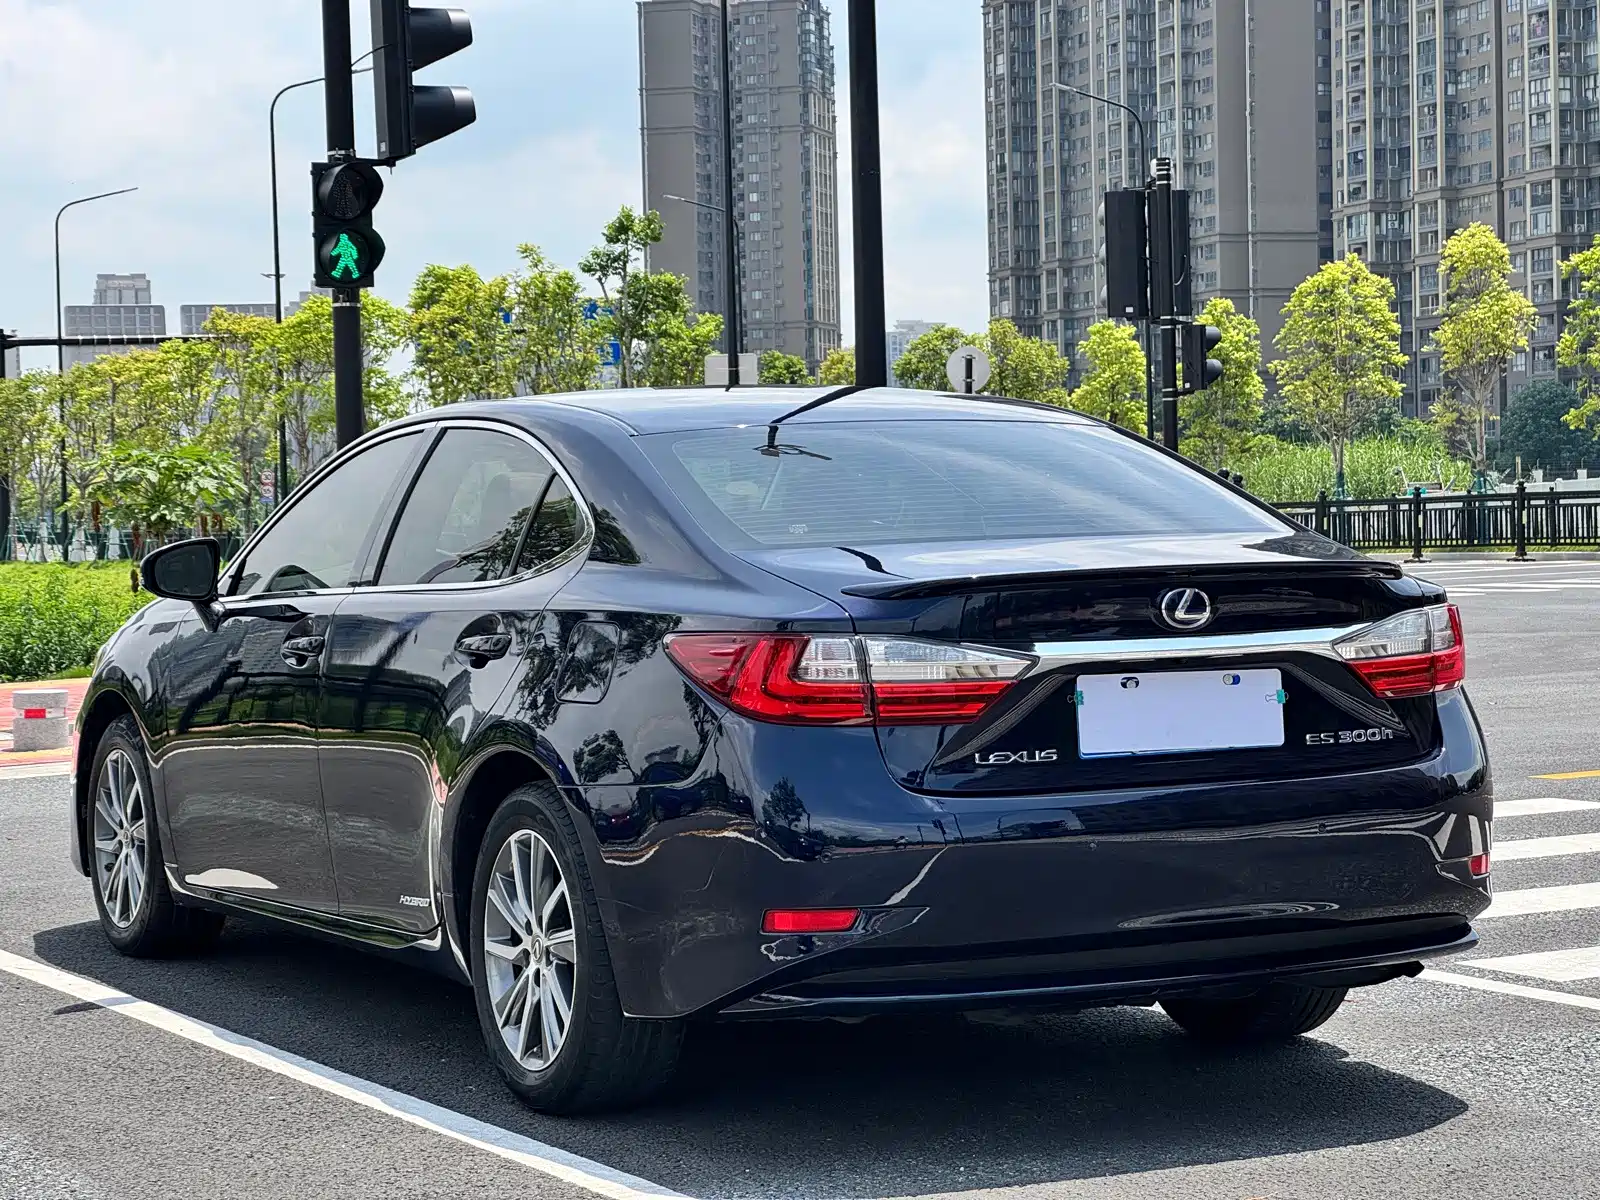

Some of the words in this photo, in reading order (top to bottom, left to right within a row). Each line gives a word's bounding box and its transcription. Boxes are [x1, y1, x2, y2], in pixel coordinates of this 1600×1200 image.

[1305, 732, 1335, 745] ES
[1338, 726, 1394, 744] 300h
[974, 748, 1059, 765] LEXUS
[399, 895, 430, 907] HYBRID
